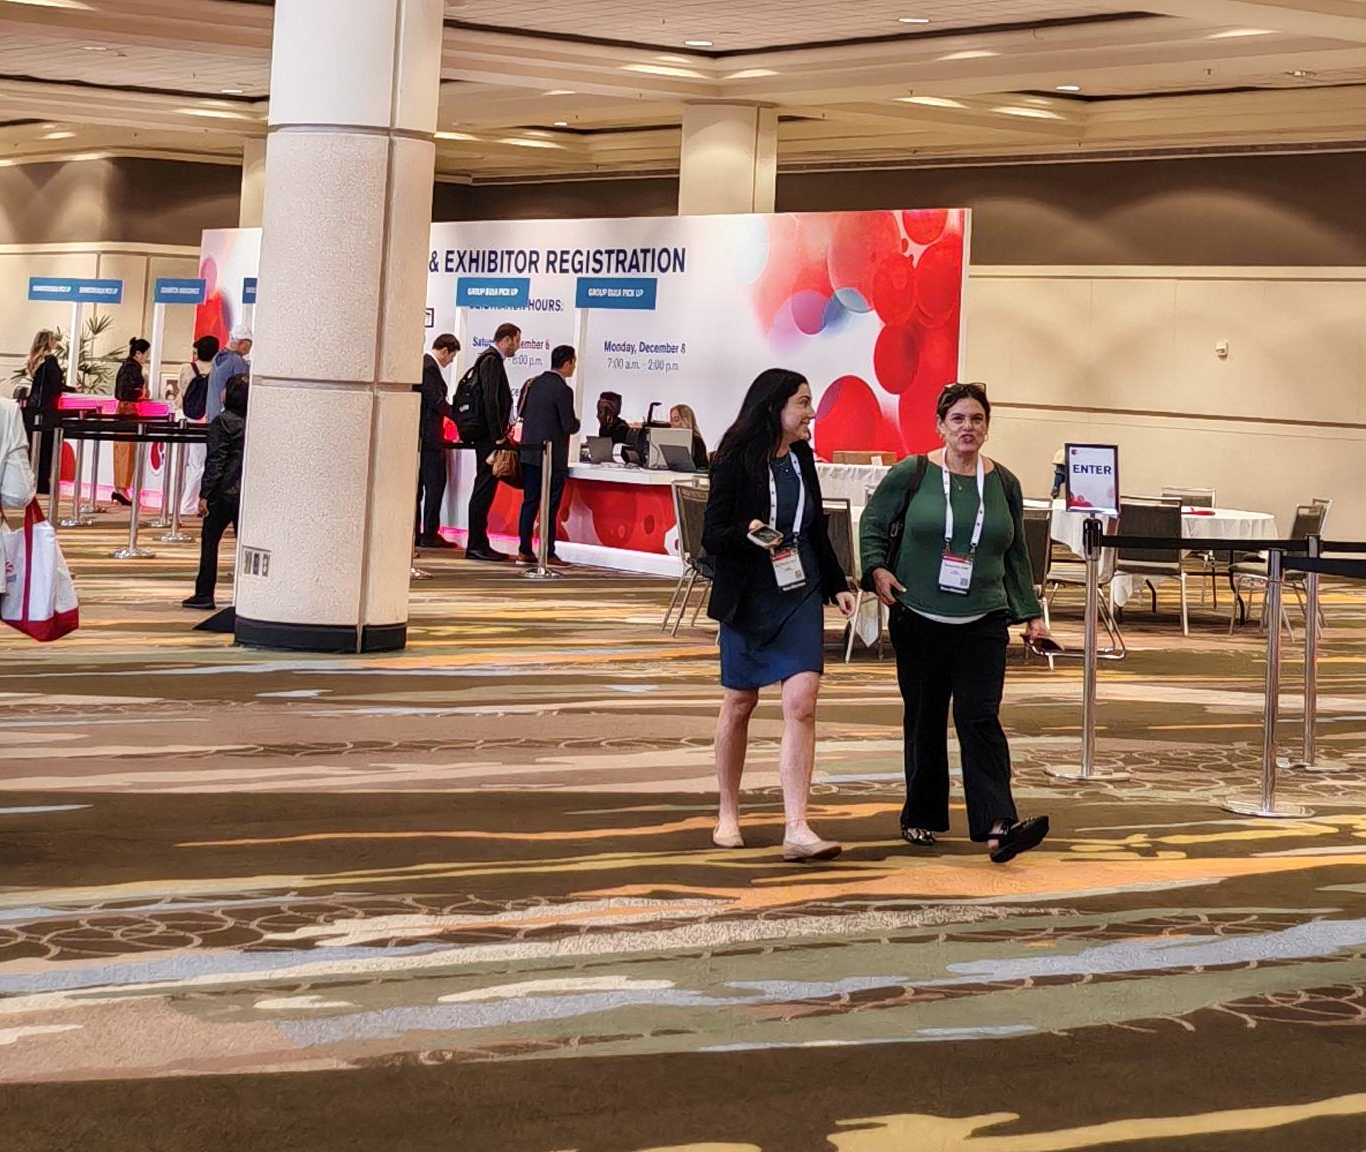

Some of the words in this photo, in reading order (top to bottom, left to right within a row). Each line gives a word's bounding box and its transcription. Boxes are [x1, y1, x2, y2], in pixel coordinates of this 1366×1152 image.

[429, 250, 440, 273] &
[444, 249, 540, 273] EXHIBITOR
[545, 248, 686, 274] REGISTRATION
[639, 341, 679, 353] December
[1072, 463, 1112, 475] ENTER
